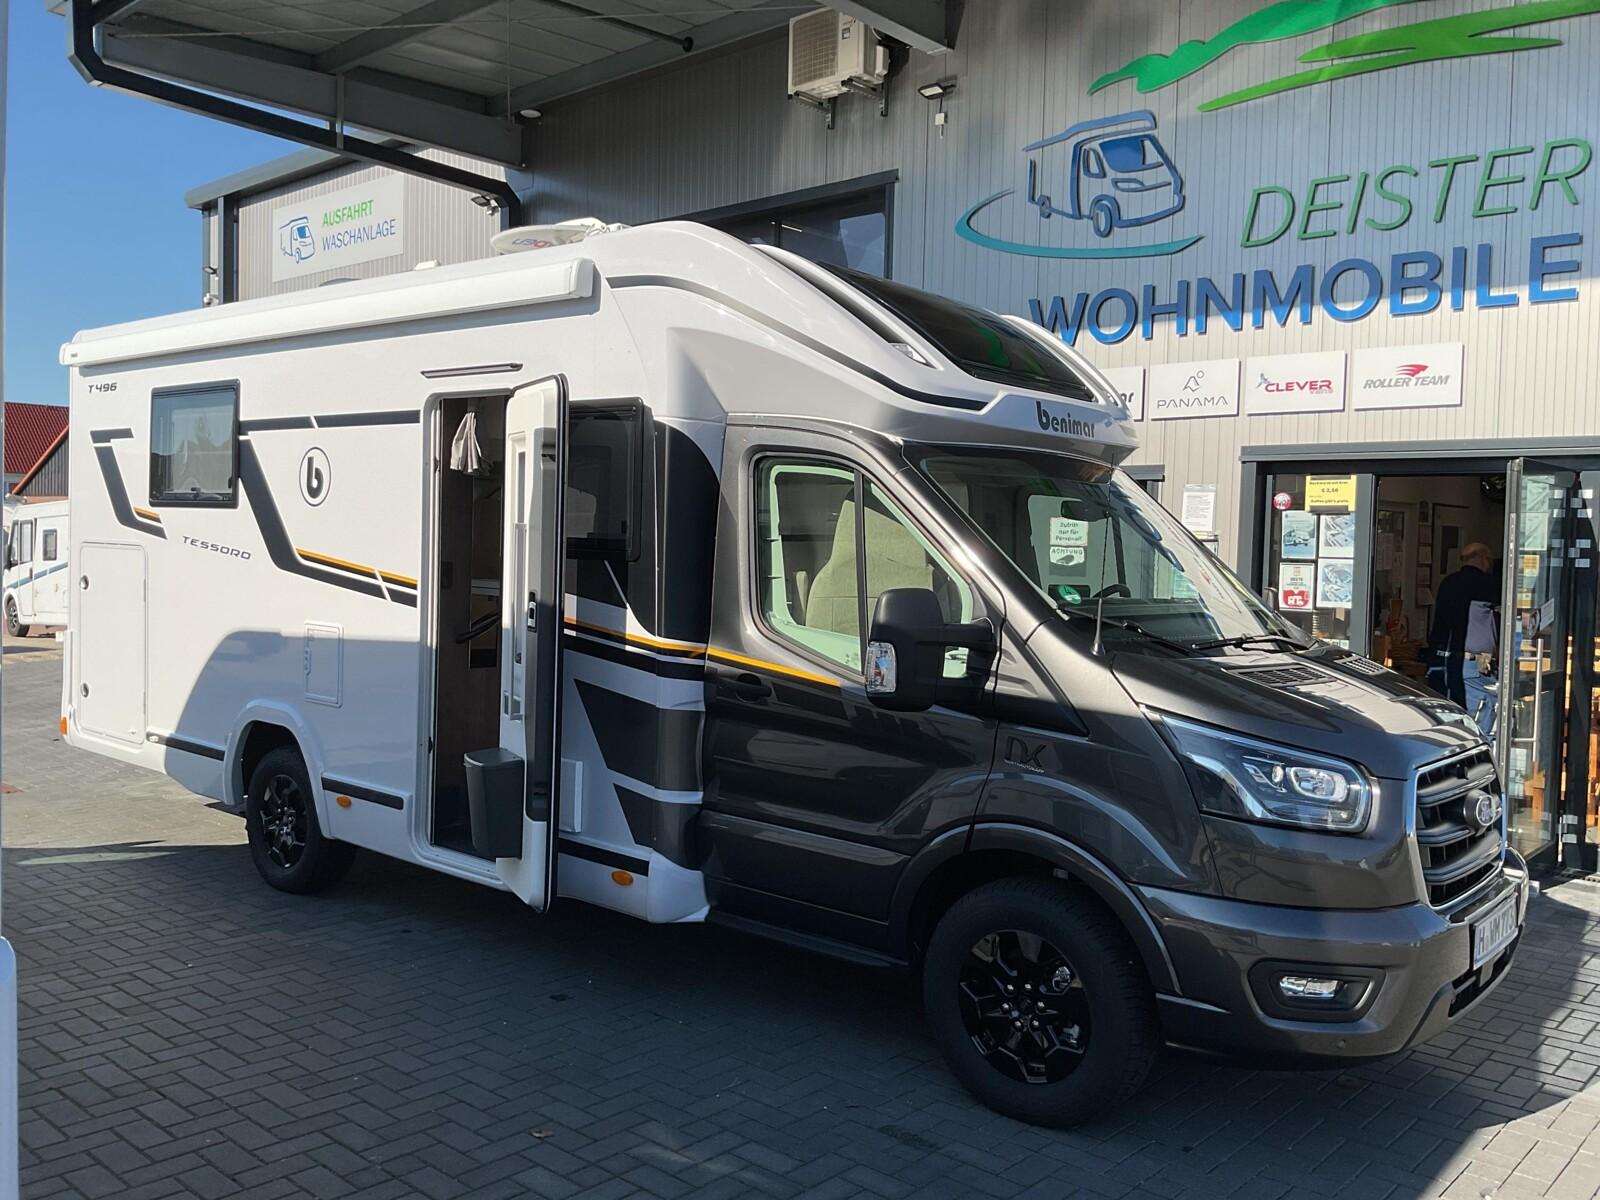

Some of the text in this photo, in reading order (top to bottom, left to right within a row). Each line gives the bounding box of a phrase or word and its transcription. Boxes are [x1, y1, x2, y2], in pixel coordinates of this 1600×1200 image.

[1240, 137, 1592, 248] DEISTER
[322, 200, 374, 227] AUSFAHRT
[322, 219, 396, 251] WASCHANLAGE
[1028, 232, 1583, 347] WOHNMOBILE
[1264, 379, 1333, 393] CLEVER
[1363, 375, 1451, 389] ROLLER TEAM
[1157, 396, 1228, 408] PANAMA
[1036, 401, 1095, 438] benimar
[182, 536, 251, 560] TESSORO
